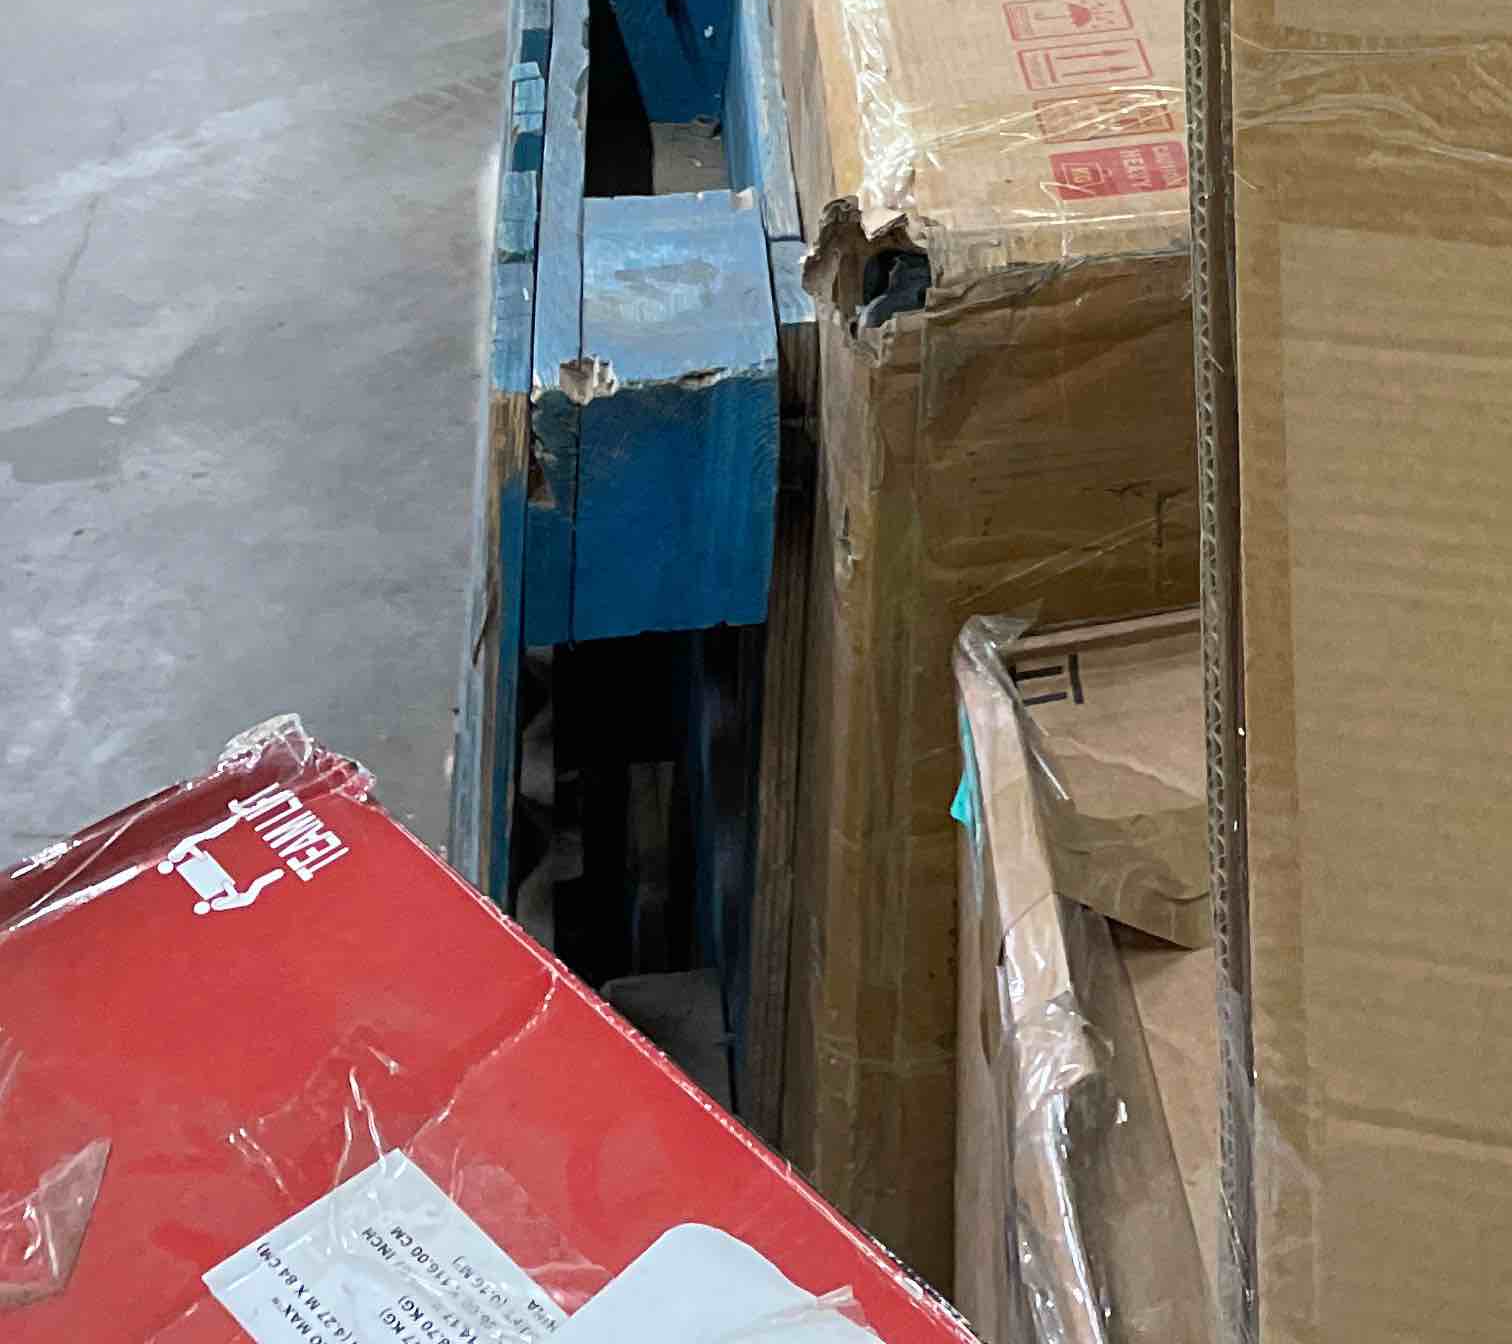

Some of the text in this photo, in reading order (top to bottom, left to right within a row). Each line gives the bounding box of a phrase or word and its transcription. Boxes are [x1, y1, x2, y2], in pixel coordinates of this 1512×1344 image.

[262, 810, 349, 881] TEAM
[361, 1227, 395, 1262] INCH
[390, 1225, 414, 1247] CM
[257, 1242, 282, 1269] CM)
[379, 1307, 405, 1334] KG)
[398, 1295, 424, 1321] KG)
